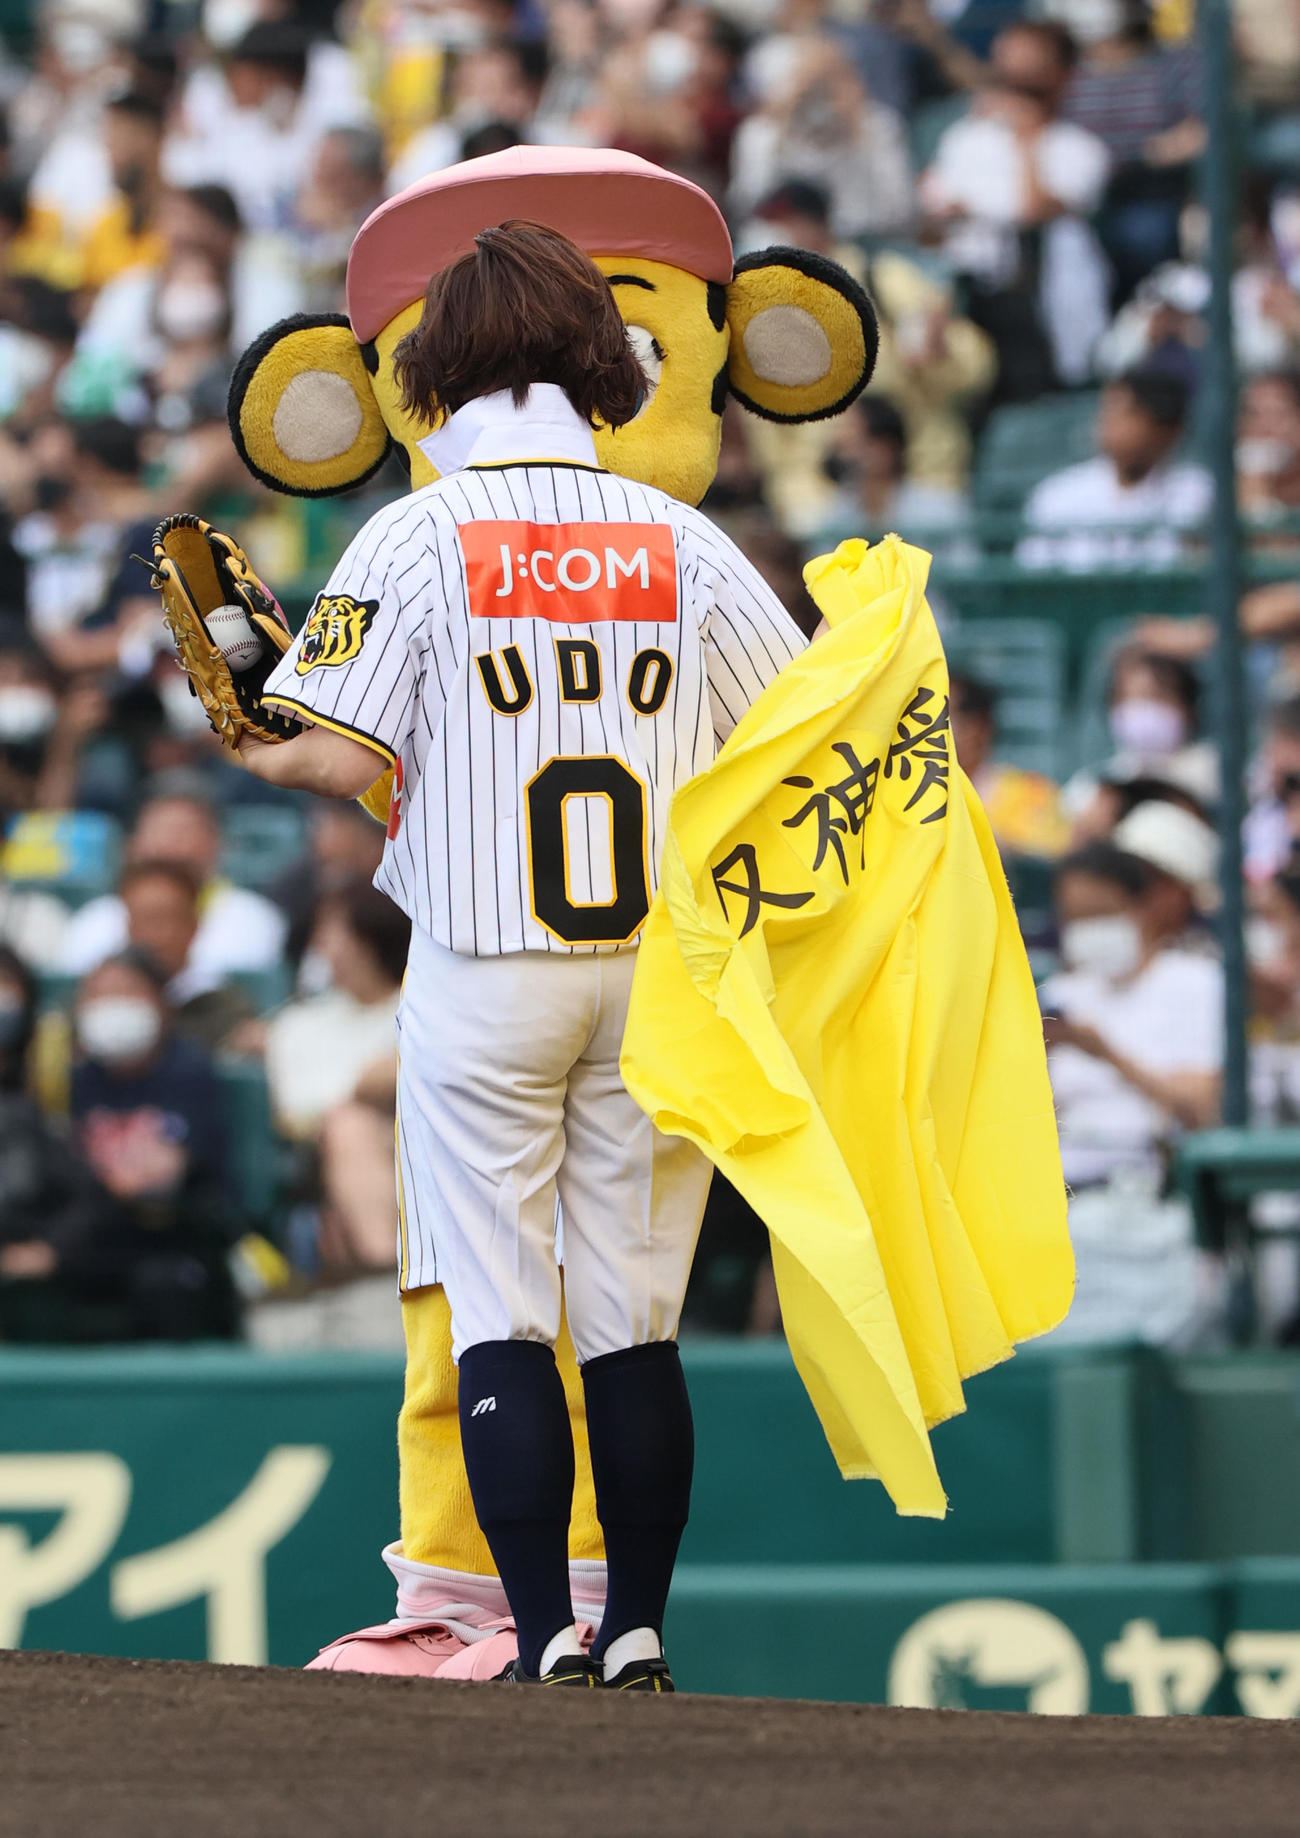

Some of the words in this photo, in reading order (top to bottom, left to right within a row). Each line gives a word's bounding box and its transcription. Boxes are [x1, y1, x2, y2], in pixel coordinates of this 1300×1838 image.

[495, 544, 650, 597] J:COM
[473, 637, 675, 717] UDO
[523, 754, 653, 947] 0
